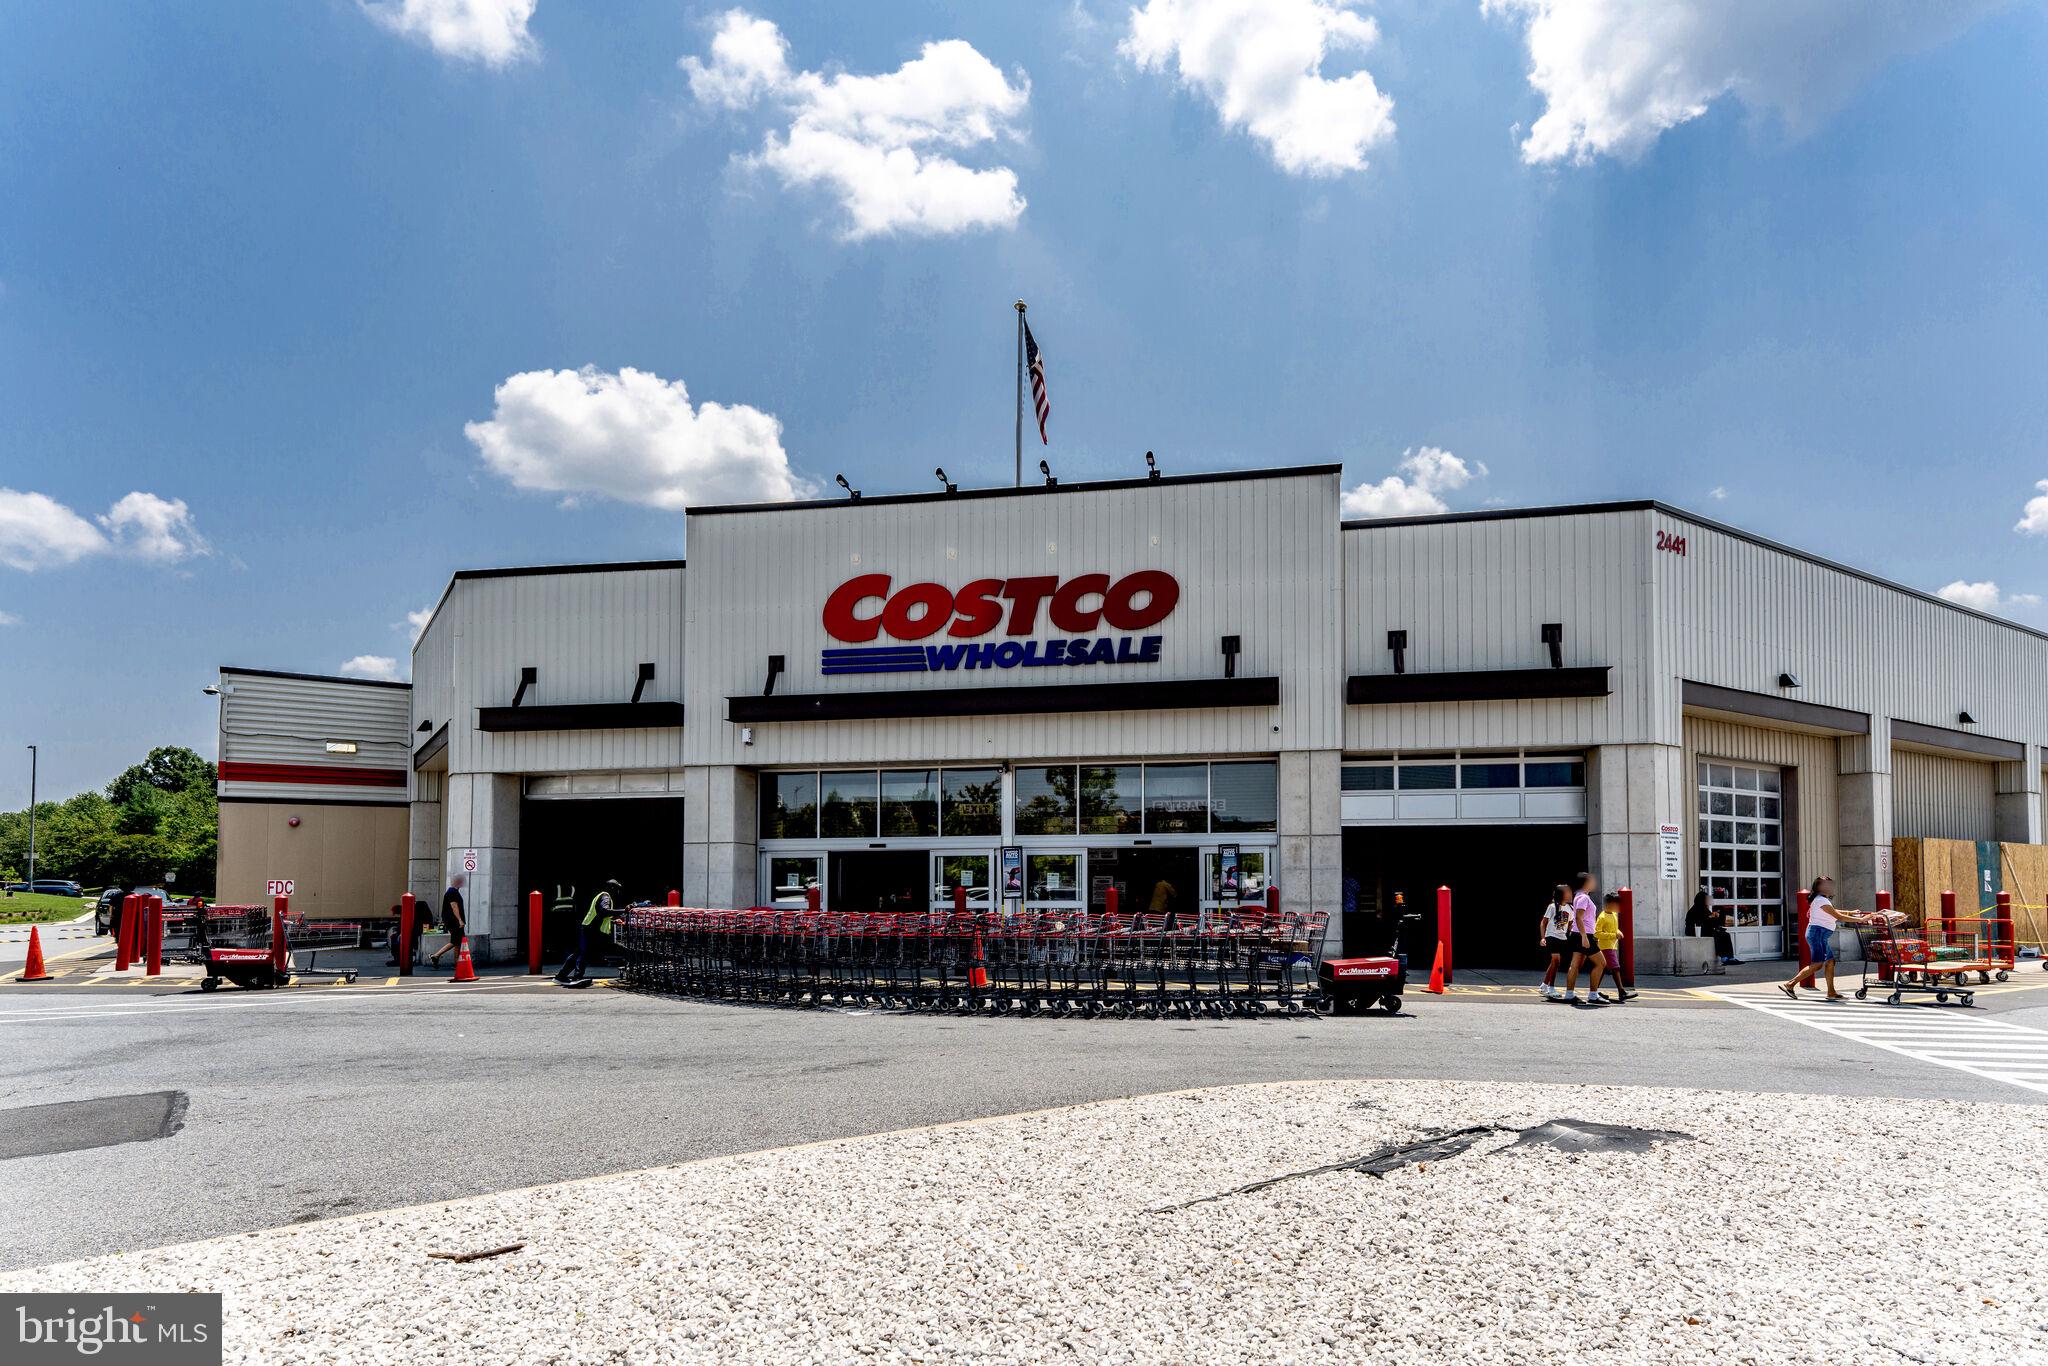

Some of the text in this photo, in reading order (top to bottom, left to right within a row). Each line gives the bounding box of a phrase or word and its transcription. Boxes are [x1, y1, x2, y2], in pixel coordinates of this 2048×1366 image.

[1657, 530, 1686, 557] 2441
[822, 569, 1180, 643] COSTCO
[925, 635, 1163, 671] WHOLESALE
[963, 804, 991, 814] EXIT
[1155, 800, 1224, 811] ENTRANCE
[267, 880, 293, 895] FDC
